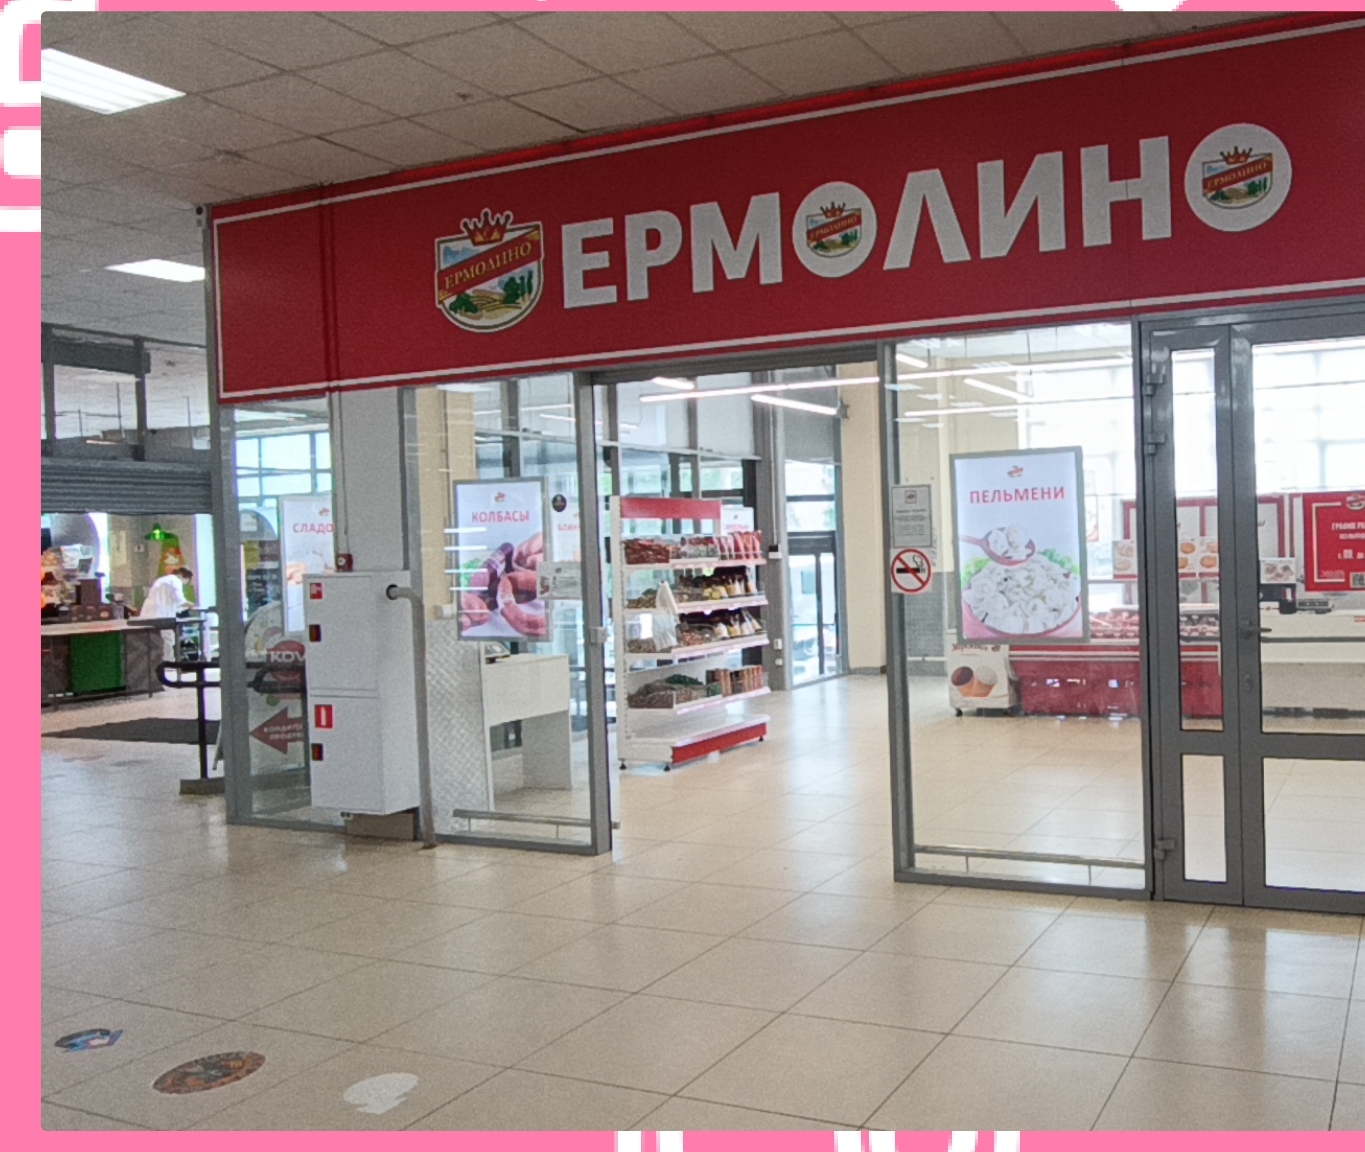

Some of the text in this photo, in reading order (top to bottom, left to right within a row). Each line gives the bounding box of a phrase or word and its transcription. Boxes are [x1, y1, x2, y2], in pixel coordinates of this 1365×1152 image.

[561, 122, 1293, 310] ЕРМОЛИНО
[444, 241, 533, 290] ЕРМОЛИНО
[970, 486, 1066, 504] ПЕЛЬМЕНИ
[471, 510, 530, 523] КОЛБАСЫ
